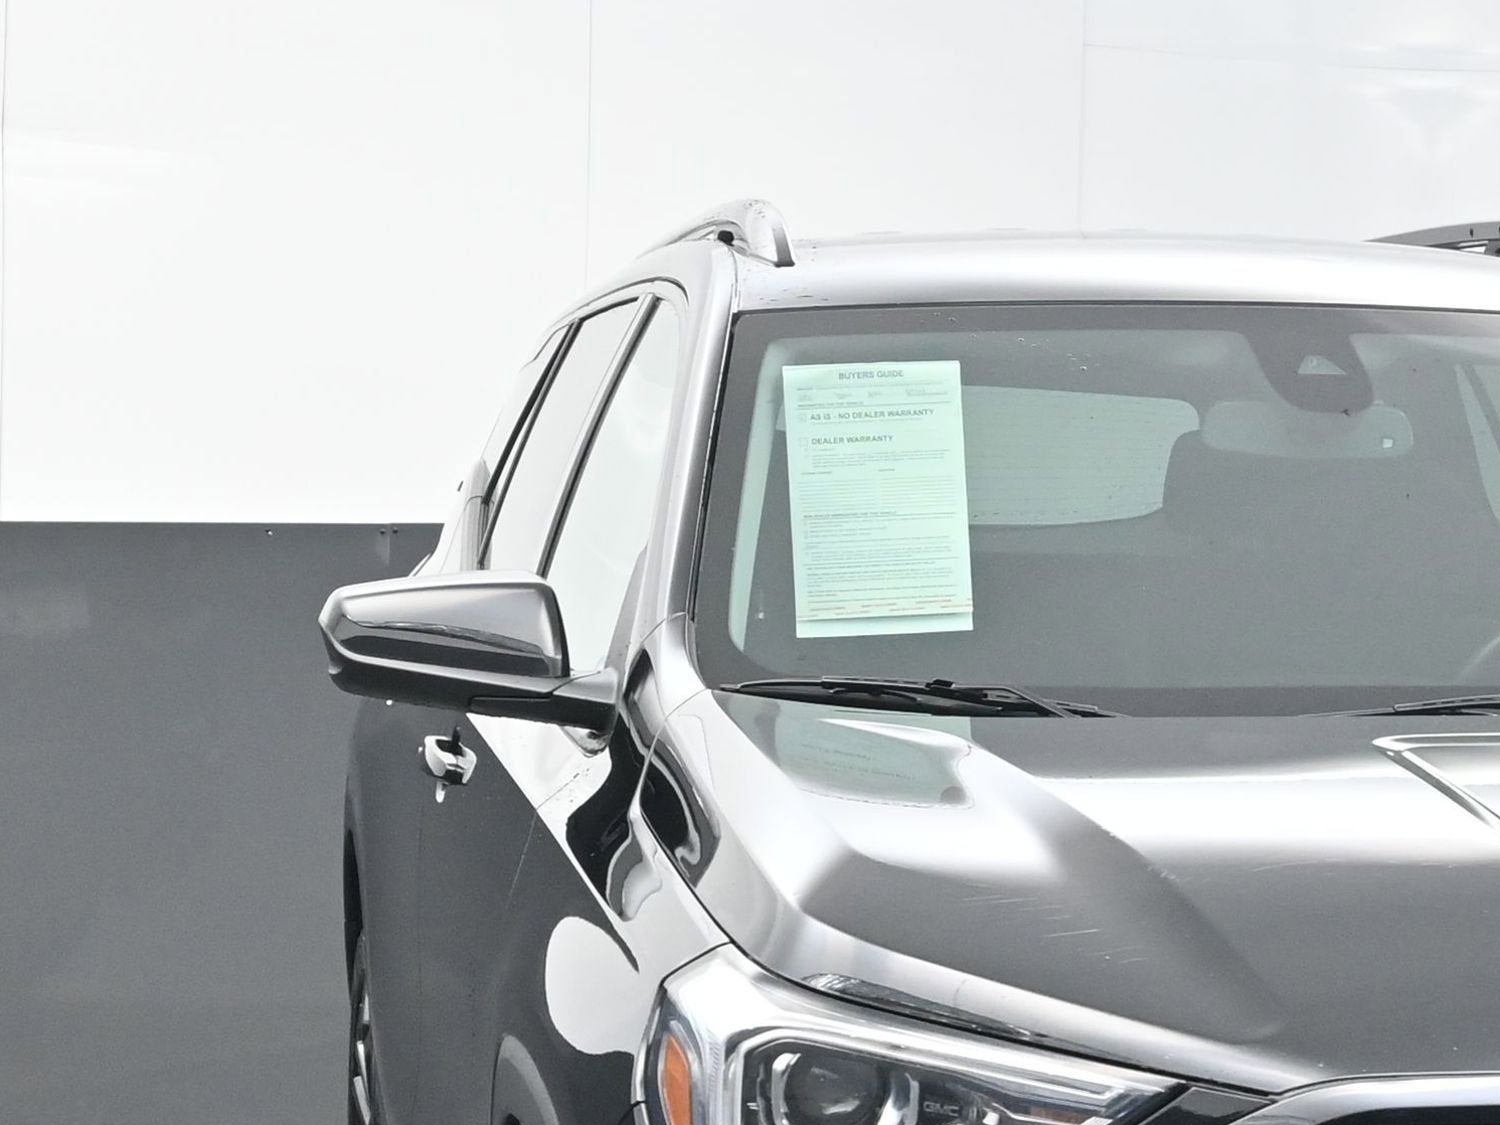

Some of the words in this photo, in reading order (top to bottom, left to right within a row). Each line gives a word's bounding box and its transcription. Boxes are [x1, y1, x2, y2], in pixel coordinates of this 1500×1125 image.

[838, 371, 875, 380] BUYERS
[876, 369, 904, 379] GUIDE
[838, 411, 850, 420] NO
[852, 409, 886, 419] DEALER
[887, 408, 934, 417] WARRANTY
[811, 436, 845, 446] DEALER
[846, 434, 893, 444] WARRANTY
